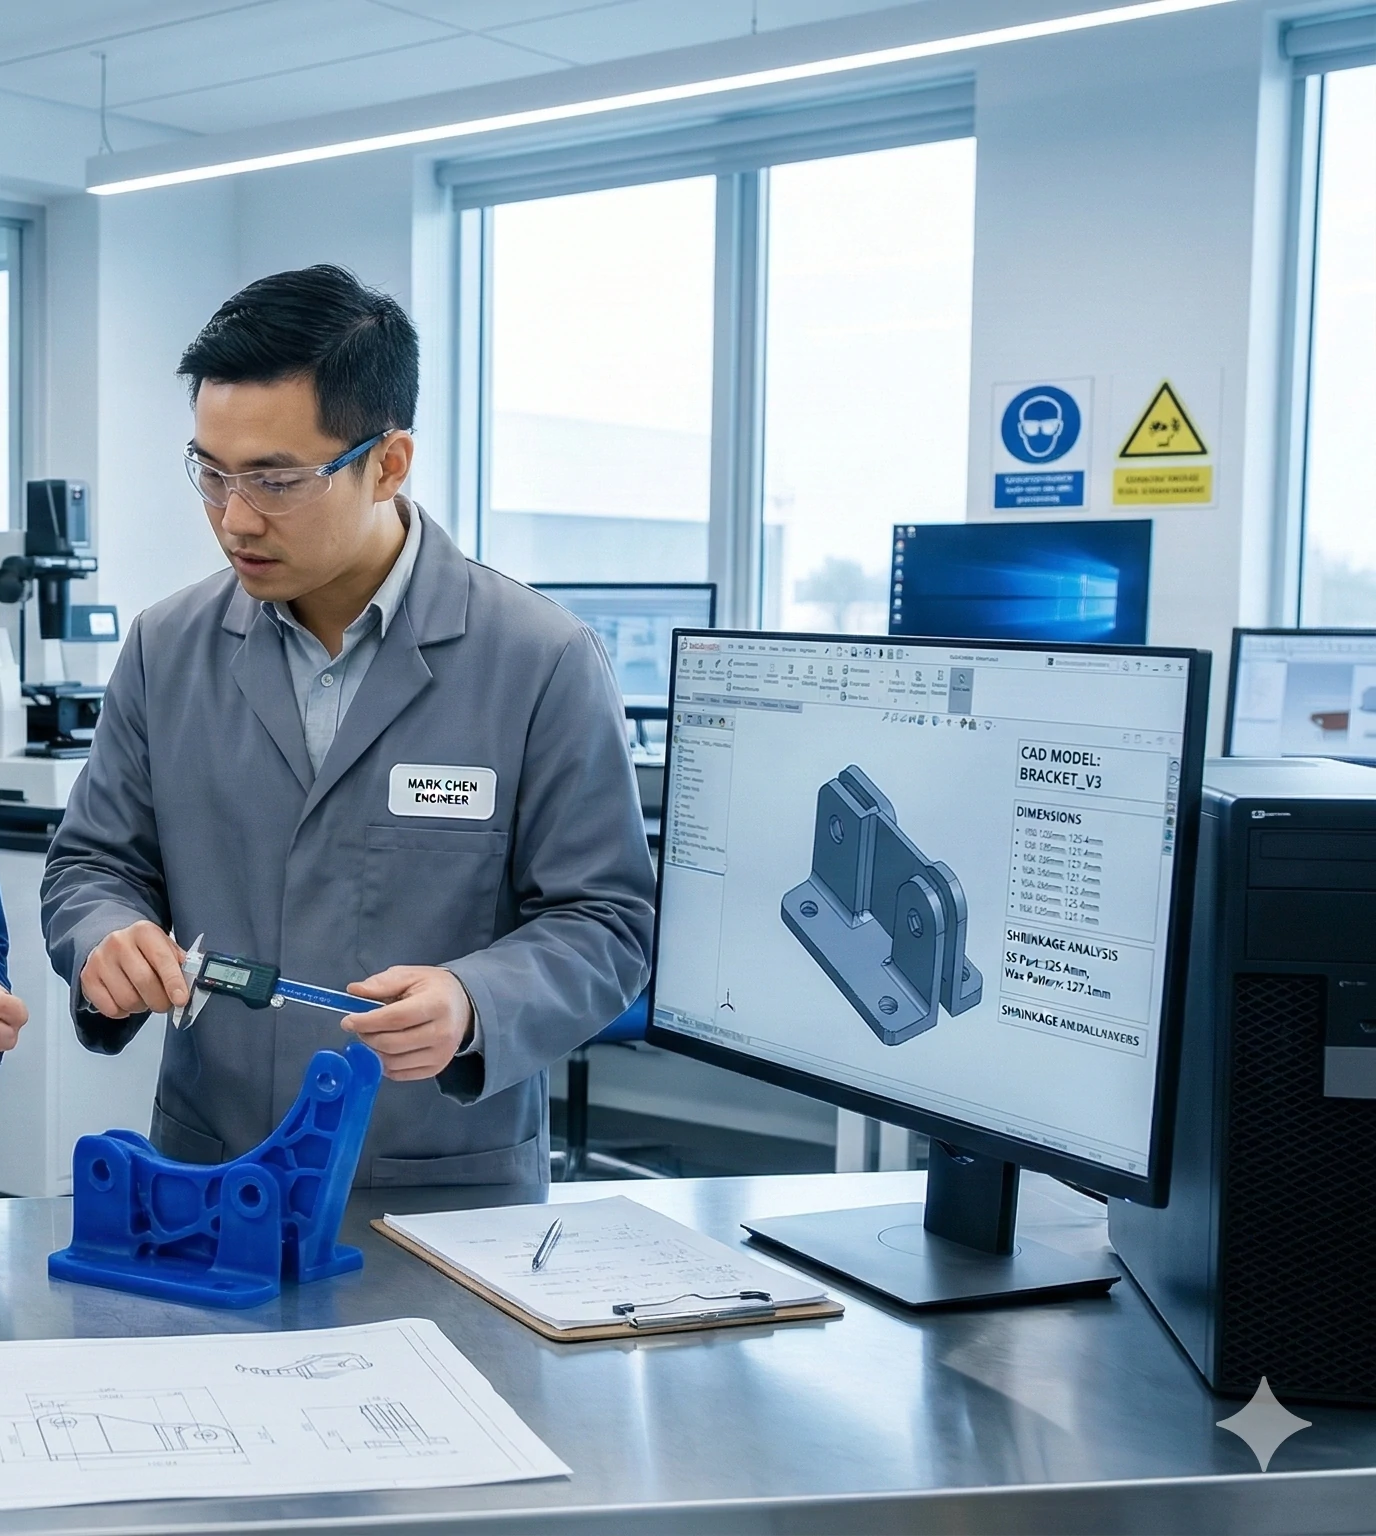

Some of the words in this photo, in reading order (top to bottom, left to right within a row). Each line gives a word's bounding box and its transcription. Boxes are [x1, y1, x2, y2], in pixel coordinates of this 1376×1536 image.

[1021, 746, 1047, 761] CAD
[1051, 749, 1101, 767] MODEL:
[408, 778, 442, 790] MARK
[445, 780, 478, 792] CHEN
[1020, 767, 1102, 790] BRACKET_V3
